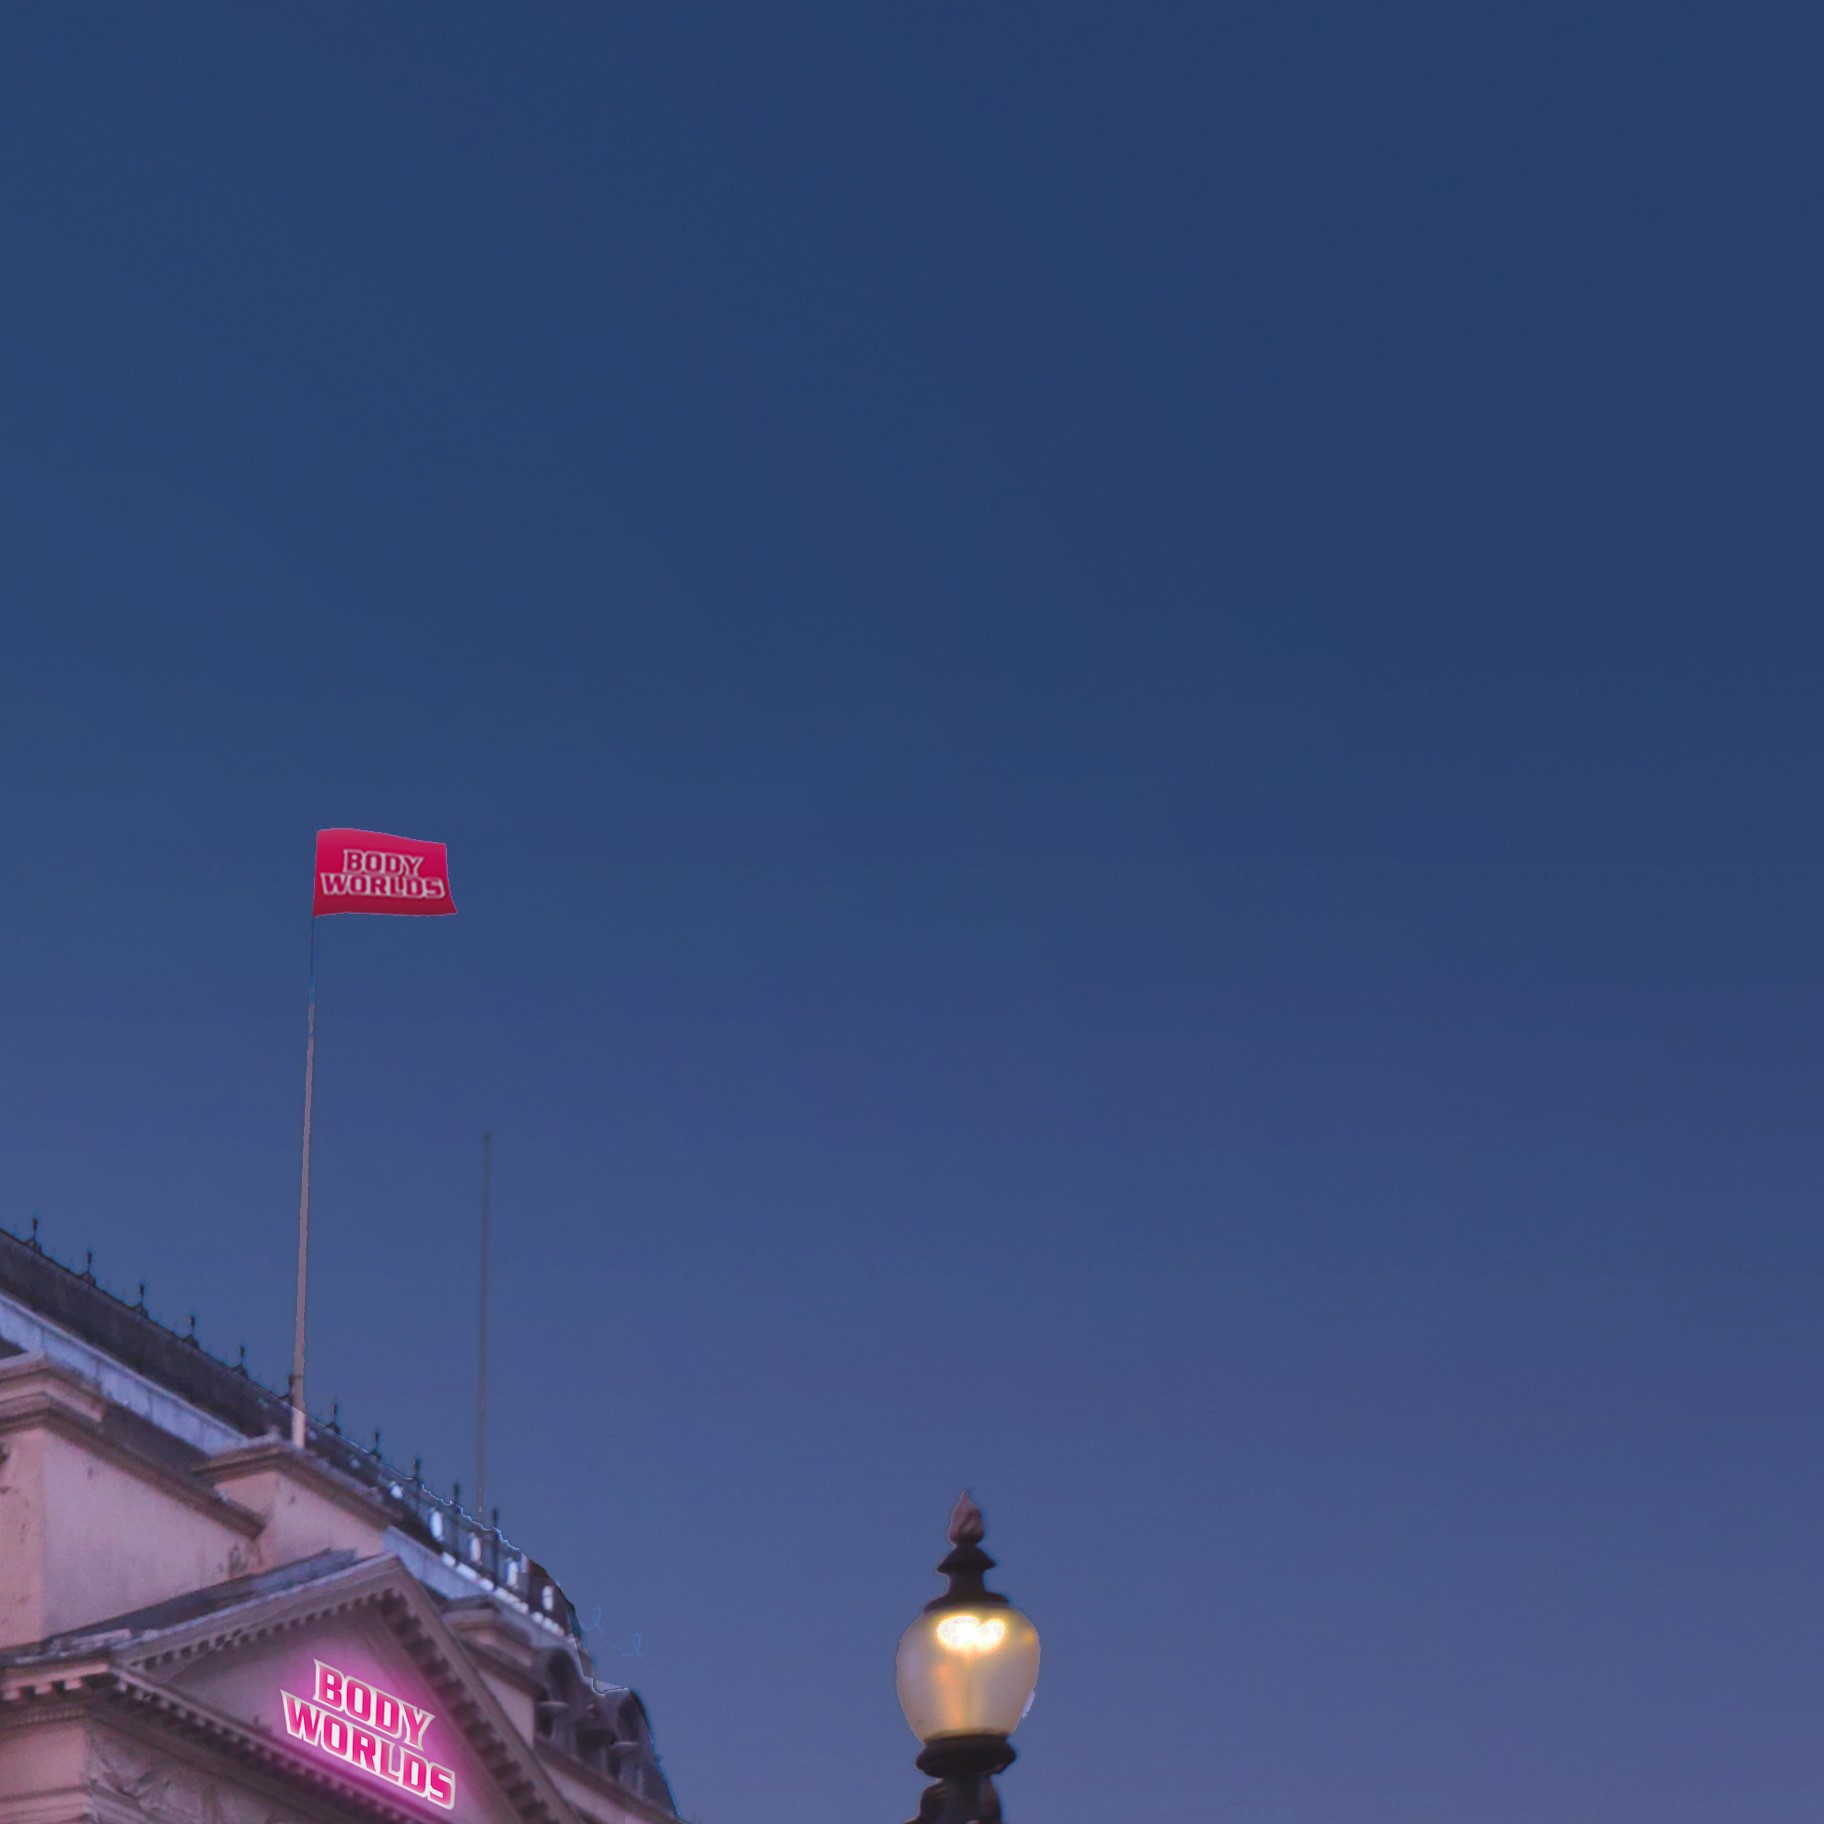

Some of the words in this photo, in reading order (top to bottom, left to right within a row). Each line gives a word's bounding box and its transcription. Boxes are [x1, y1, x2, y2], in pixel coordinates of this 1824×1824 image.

[320, 872, 445, 899] WORLDS
[343, 849, 424, 876] BODY
[312, 1658, 435, 1752] BODY
[280, 1689, 456, 1810] WORLDS
